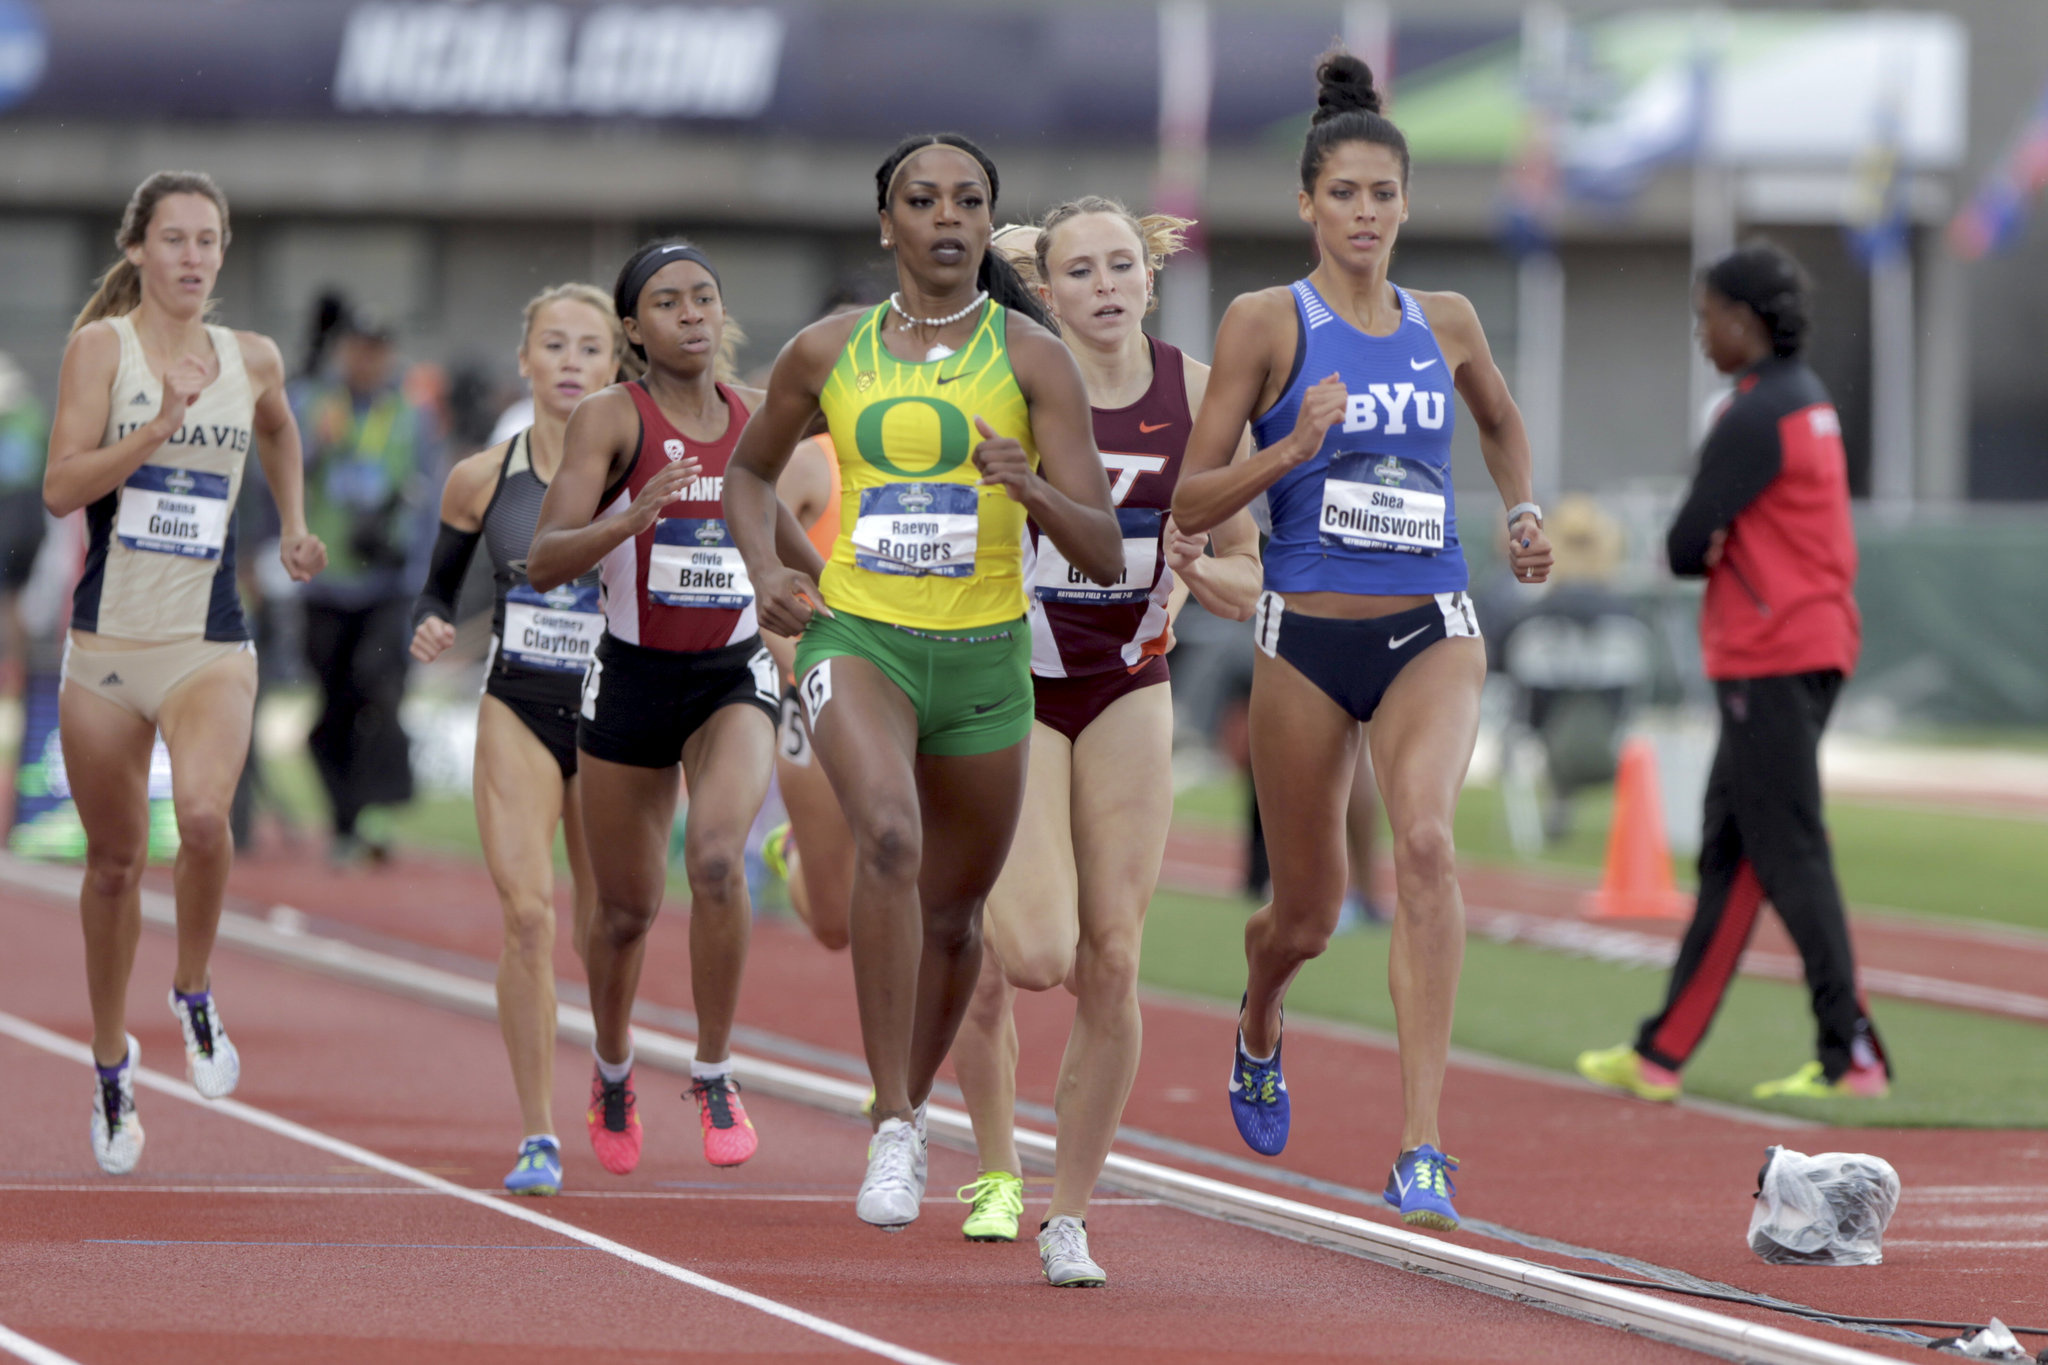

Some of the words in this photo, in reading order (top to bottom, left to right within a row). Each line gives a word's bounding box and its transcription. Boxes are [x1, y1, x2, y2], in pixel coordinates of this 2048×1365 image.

[1342, 382, 1446, 435] BYU
[168, 423, 250, 453] DAVIS
[855, 396, 970, 478] O
[1371, 491, 1404, 509] Shea
[149, 515, 199, 539] Goins
[892, 521, 939, 536] Raevyn
[1324, 504, 1442, 542] Collinsworth
[692, 552, 723, 566] Olivia
[878, 538, 951, 564] Rogers
[679, 568, 735, 589] Baker
[1057, 590, 1085, 599] HAYWARD
[1085, 591, 1101, 600] FIELD
[523, 627, 590, 654] Clayton
